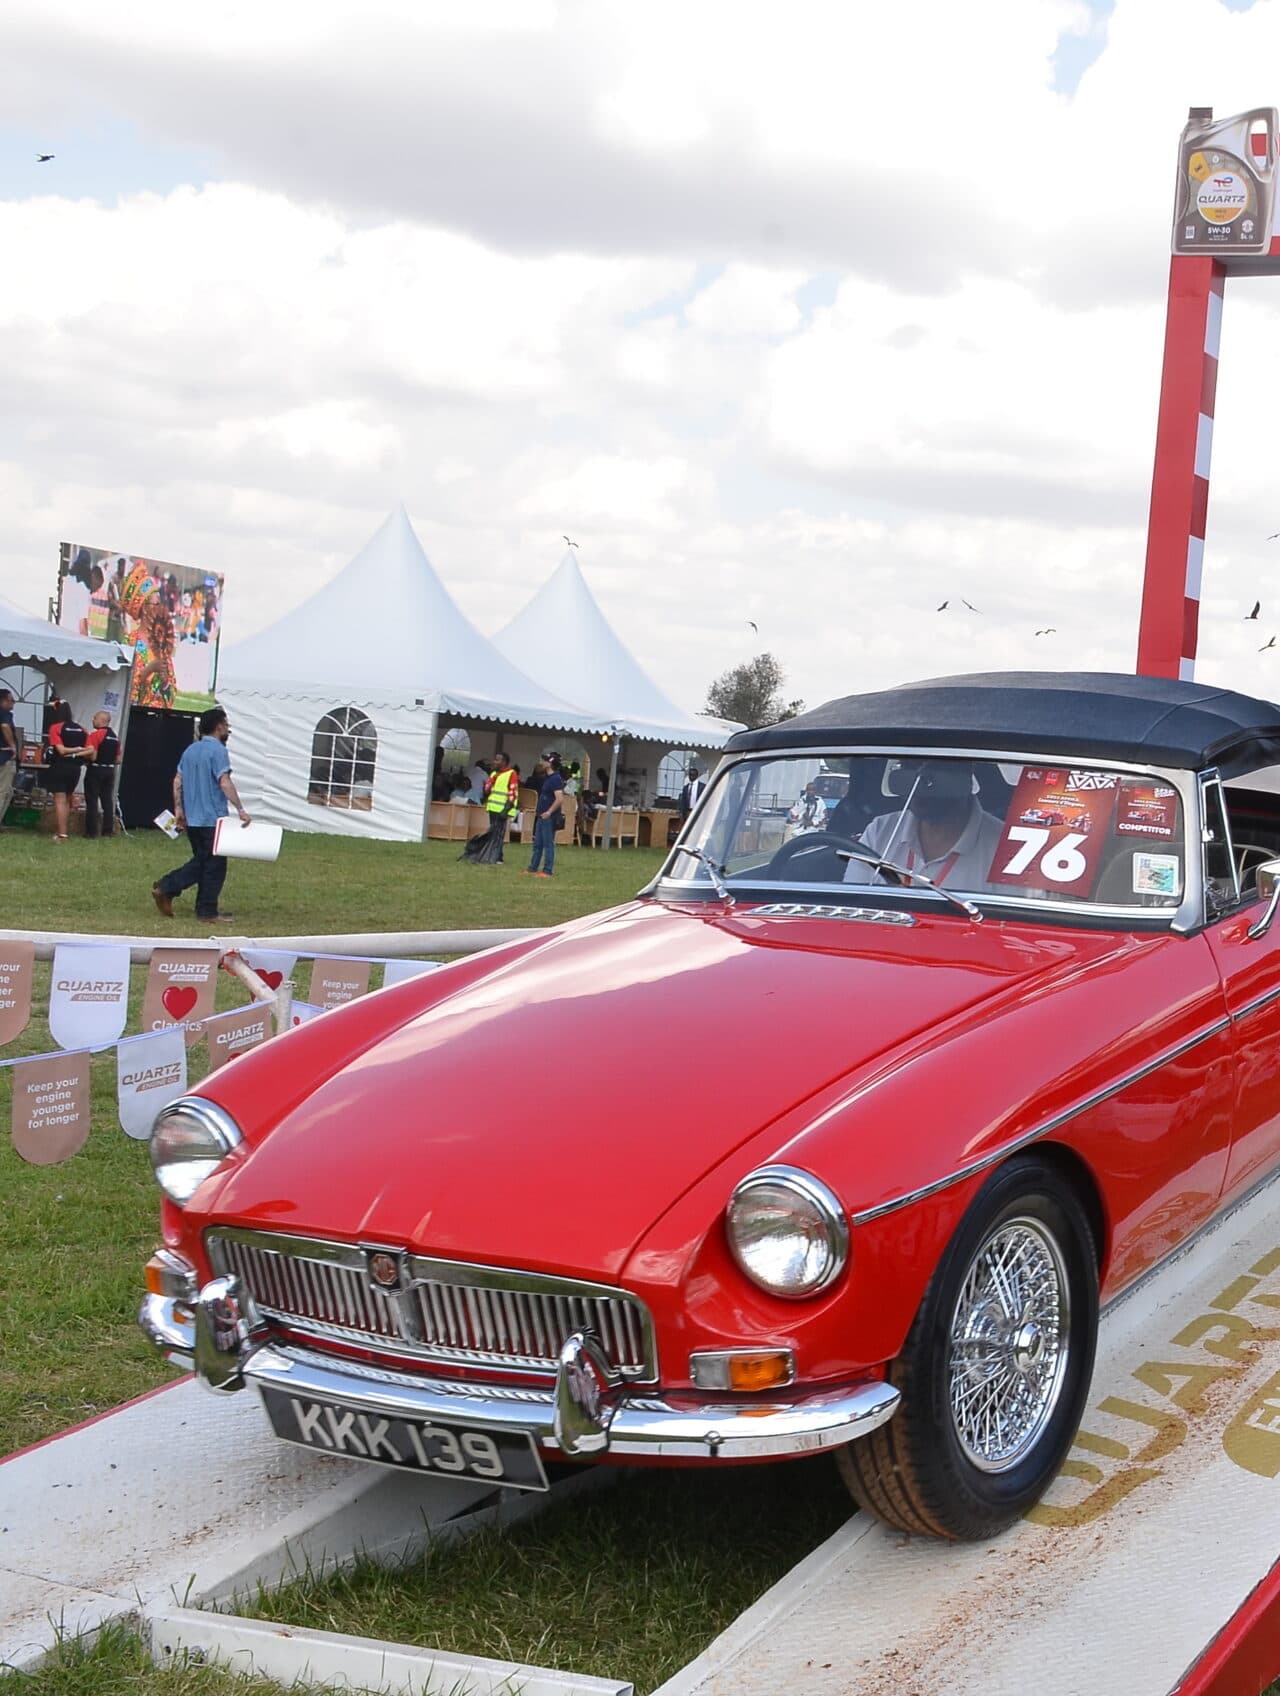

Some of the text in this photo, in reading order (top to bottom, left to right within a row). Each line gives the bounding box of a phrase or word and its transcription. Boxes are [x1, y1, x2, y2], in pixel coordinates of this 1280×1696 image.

[1199, 195, 1245, 203] QUARTZ
[1118, 823, 1171, 835] COMPETITOR
[1002, 826, 1088, 882] 76
[158, 963, 210, 974] QUARTZ
[57, 980, 124, 993] QUARTZ
[322, 980, 341, 991] Keep
[216, 1021, 264, 1045] QUARTZ
[122, 1062, 181, 1086] QUARTZ
[27, 1077, 79, 1095] Keep your
[35, 1090, 71, 1105] engine
[32, 1102, 76, 1118] younger
[28, 1112, 80, 1129] for longer
[290, 1398, 504, 1478] KKK 139
